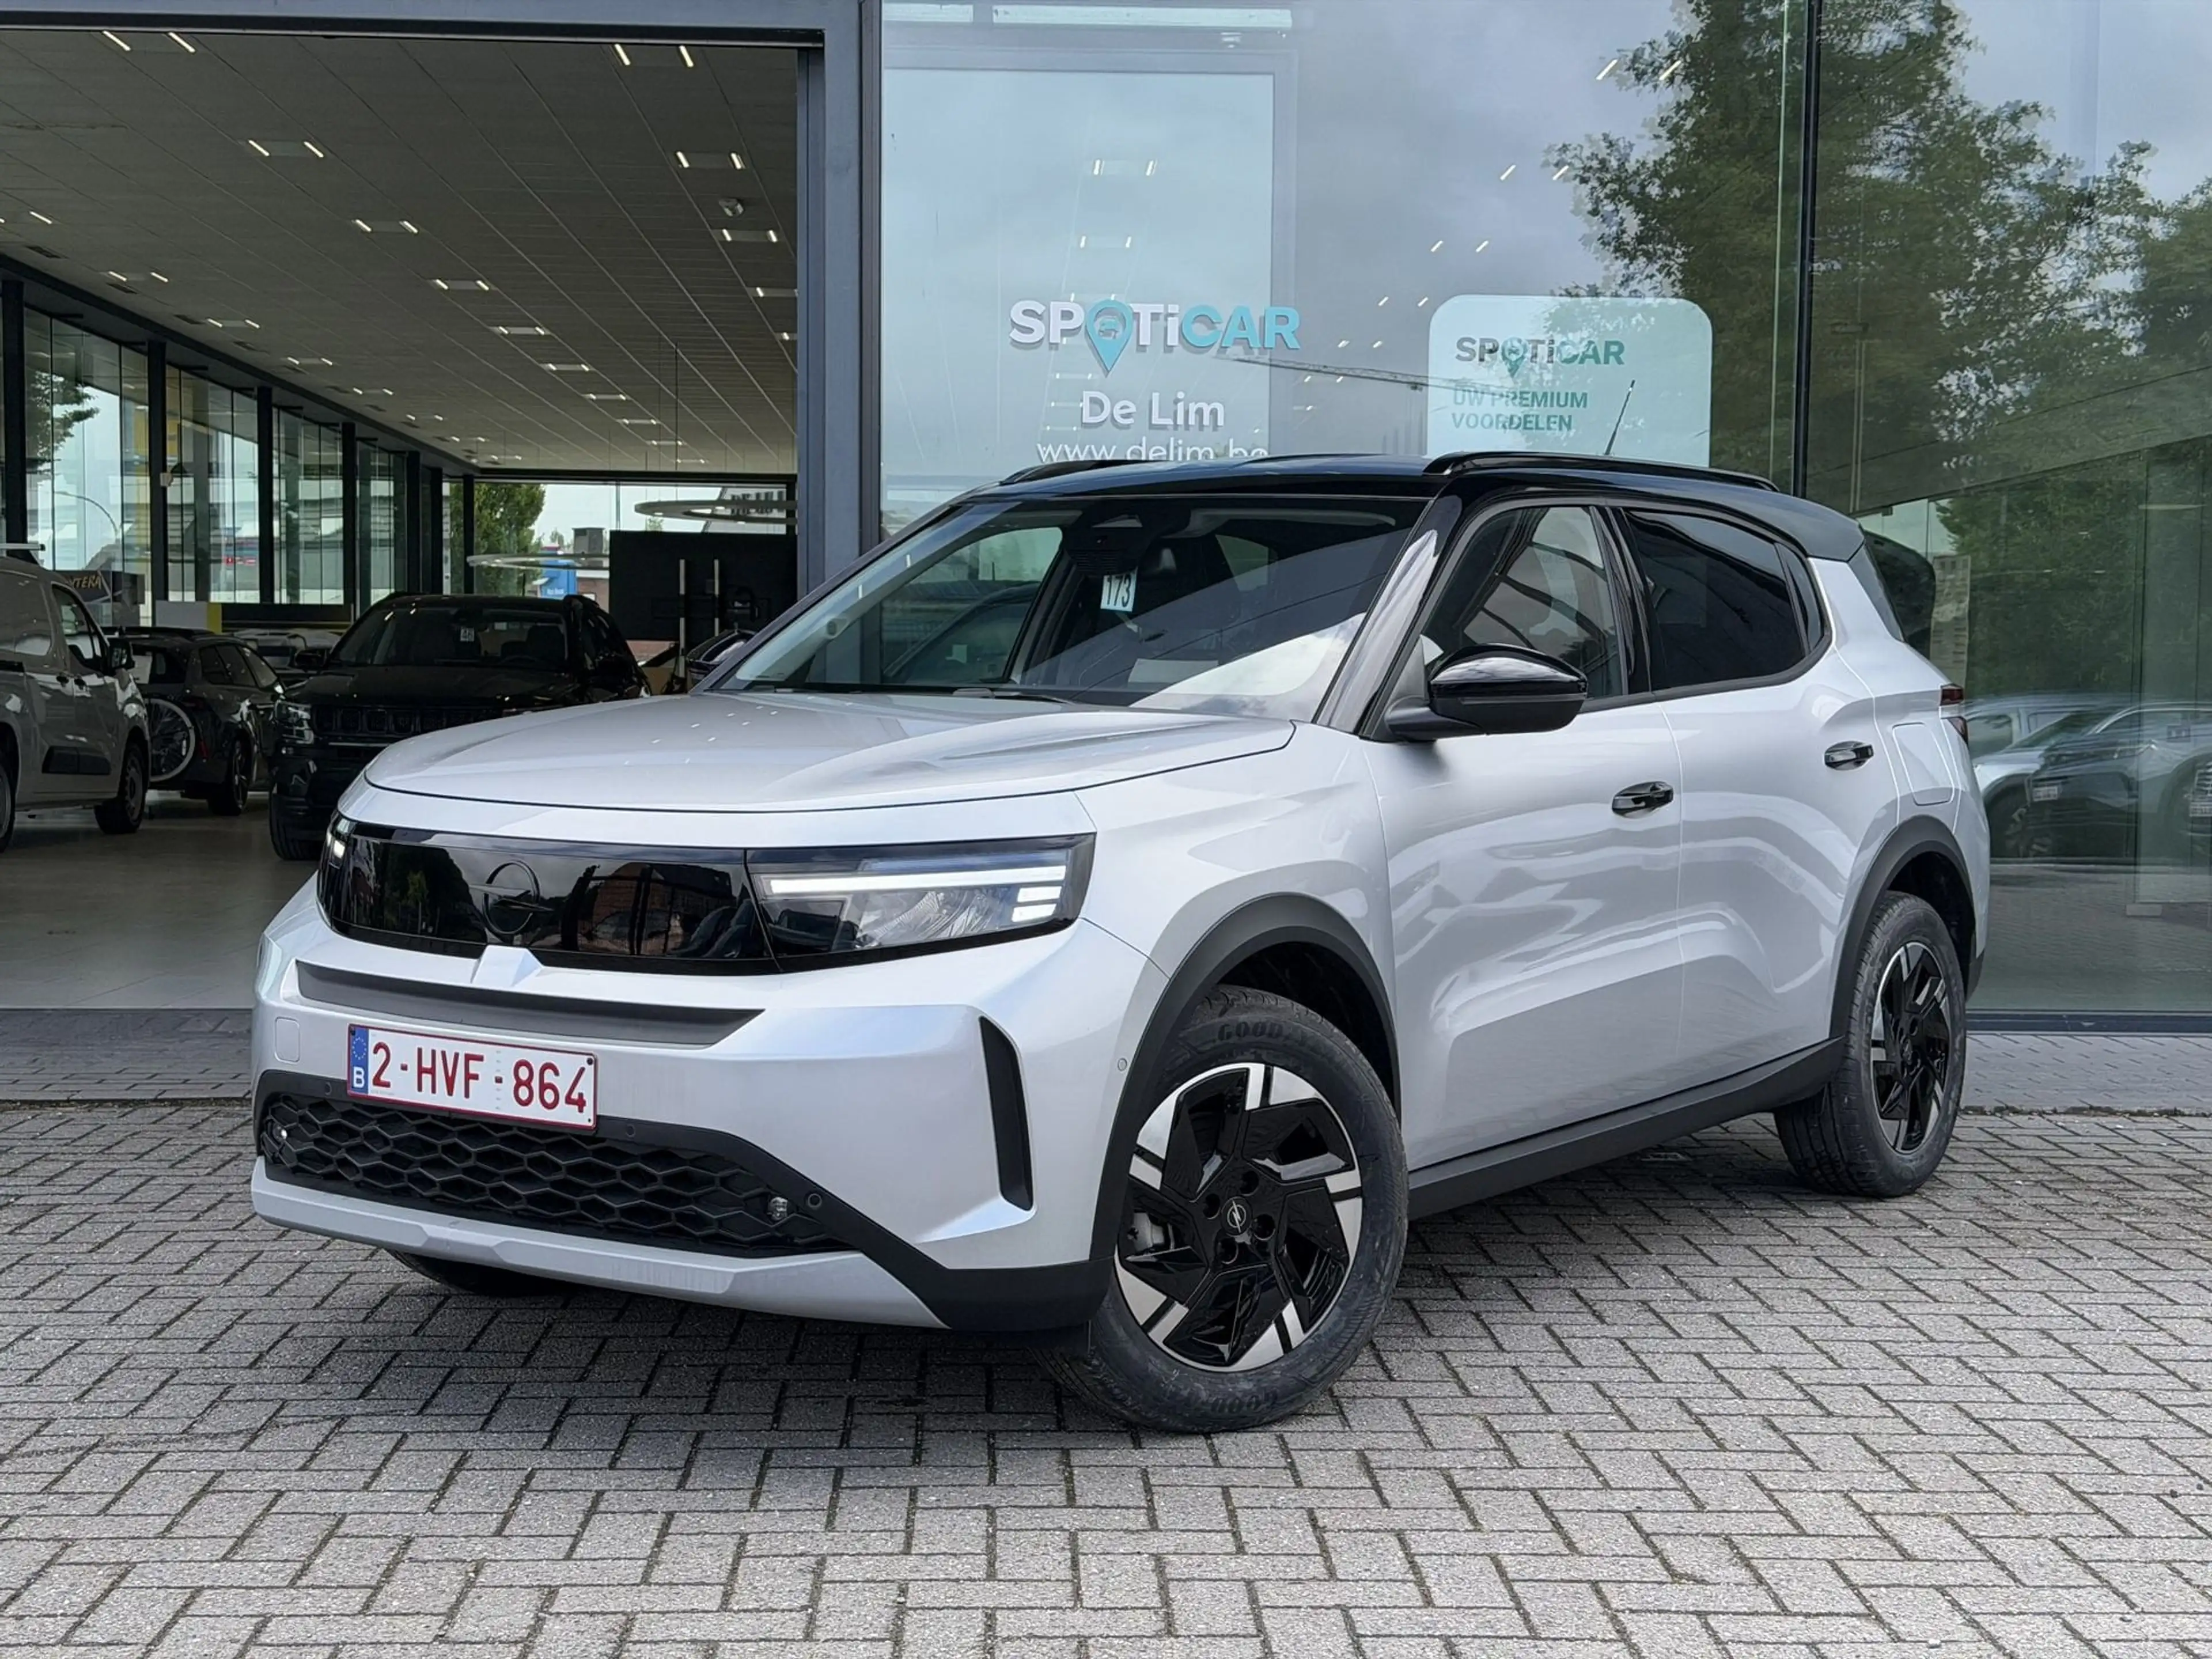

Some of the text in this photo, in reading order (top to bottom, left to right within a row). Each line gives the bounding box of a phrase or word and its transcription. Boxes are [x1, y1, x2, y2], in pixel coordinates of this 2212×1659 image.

[1081, 391, 1225, 427] De Lim
[1453, 388, 1588, 408] UW PREMIUM
[1452, 412, 1573, 431] VOORDELEN
[1037, 436, 1268, 463] wwwdelimb
[1106, 574, 1132, 608] 173
[353, 1066, 365, 1088] B
